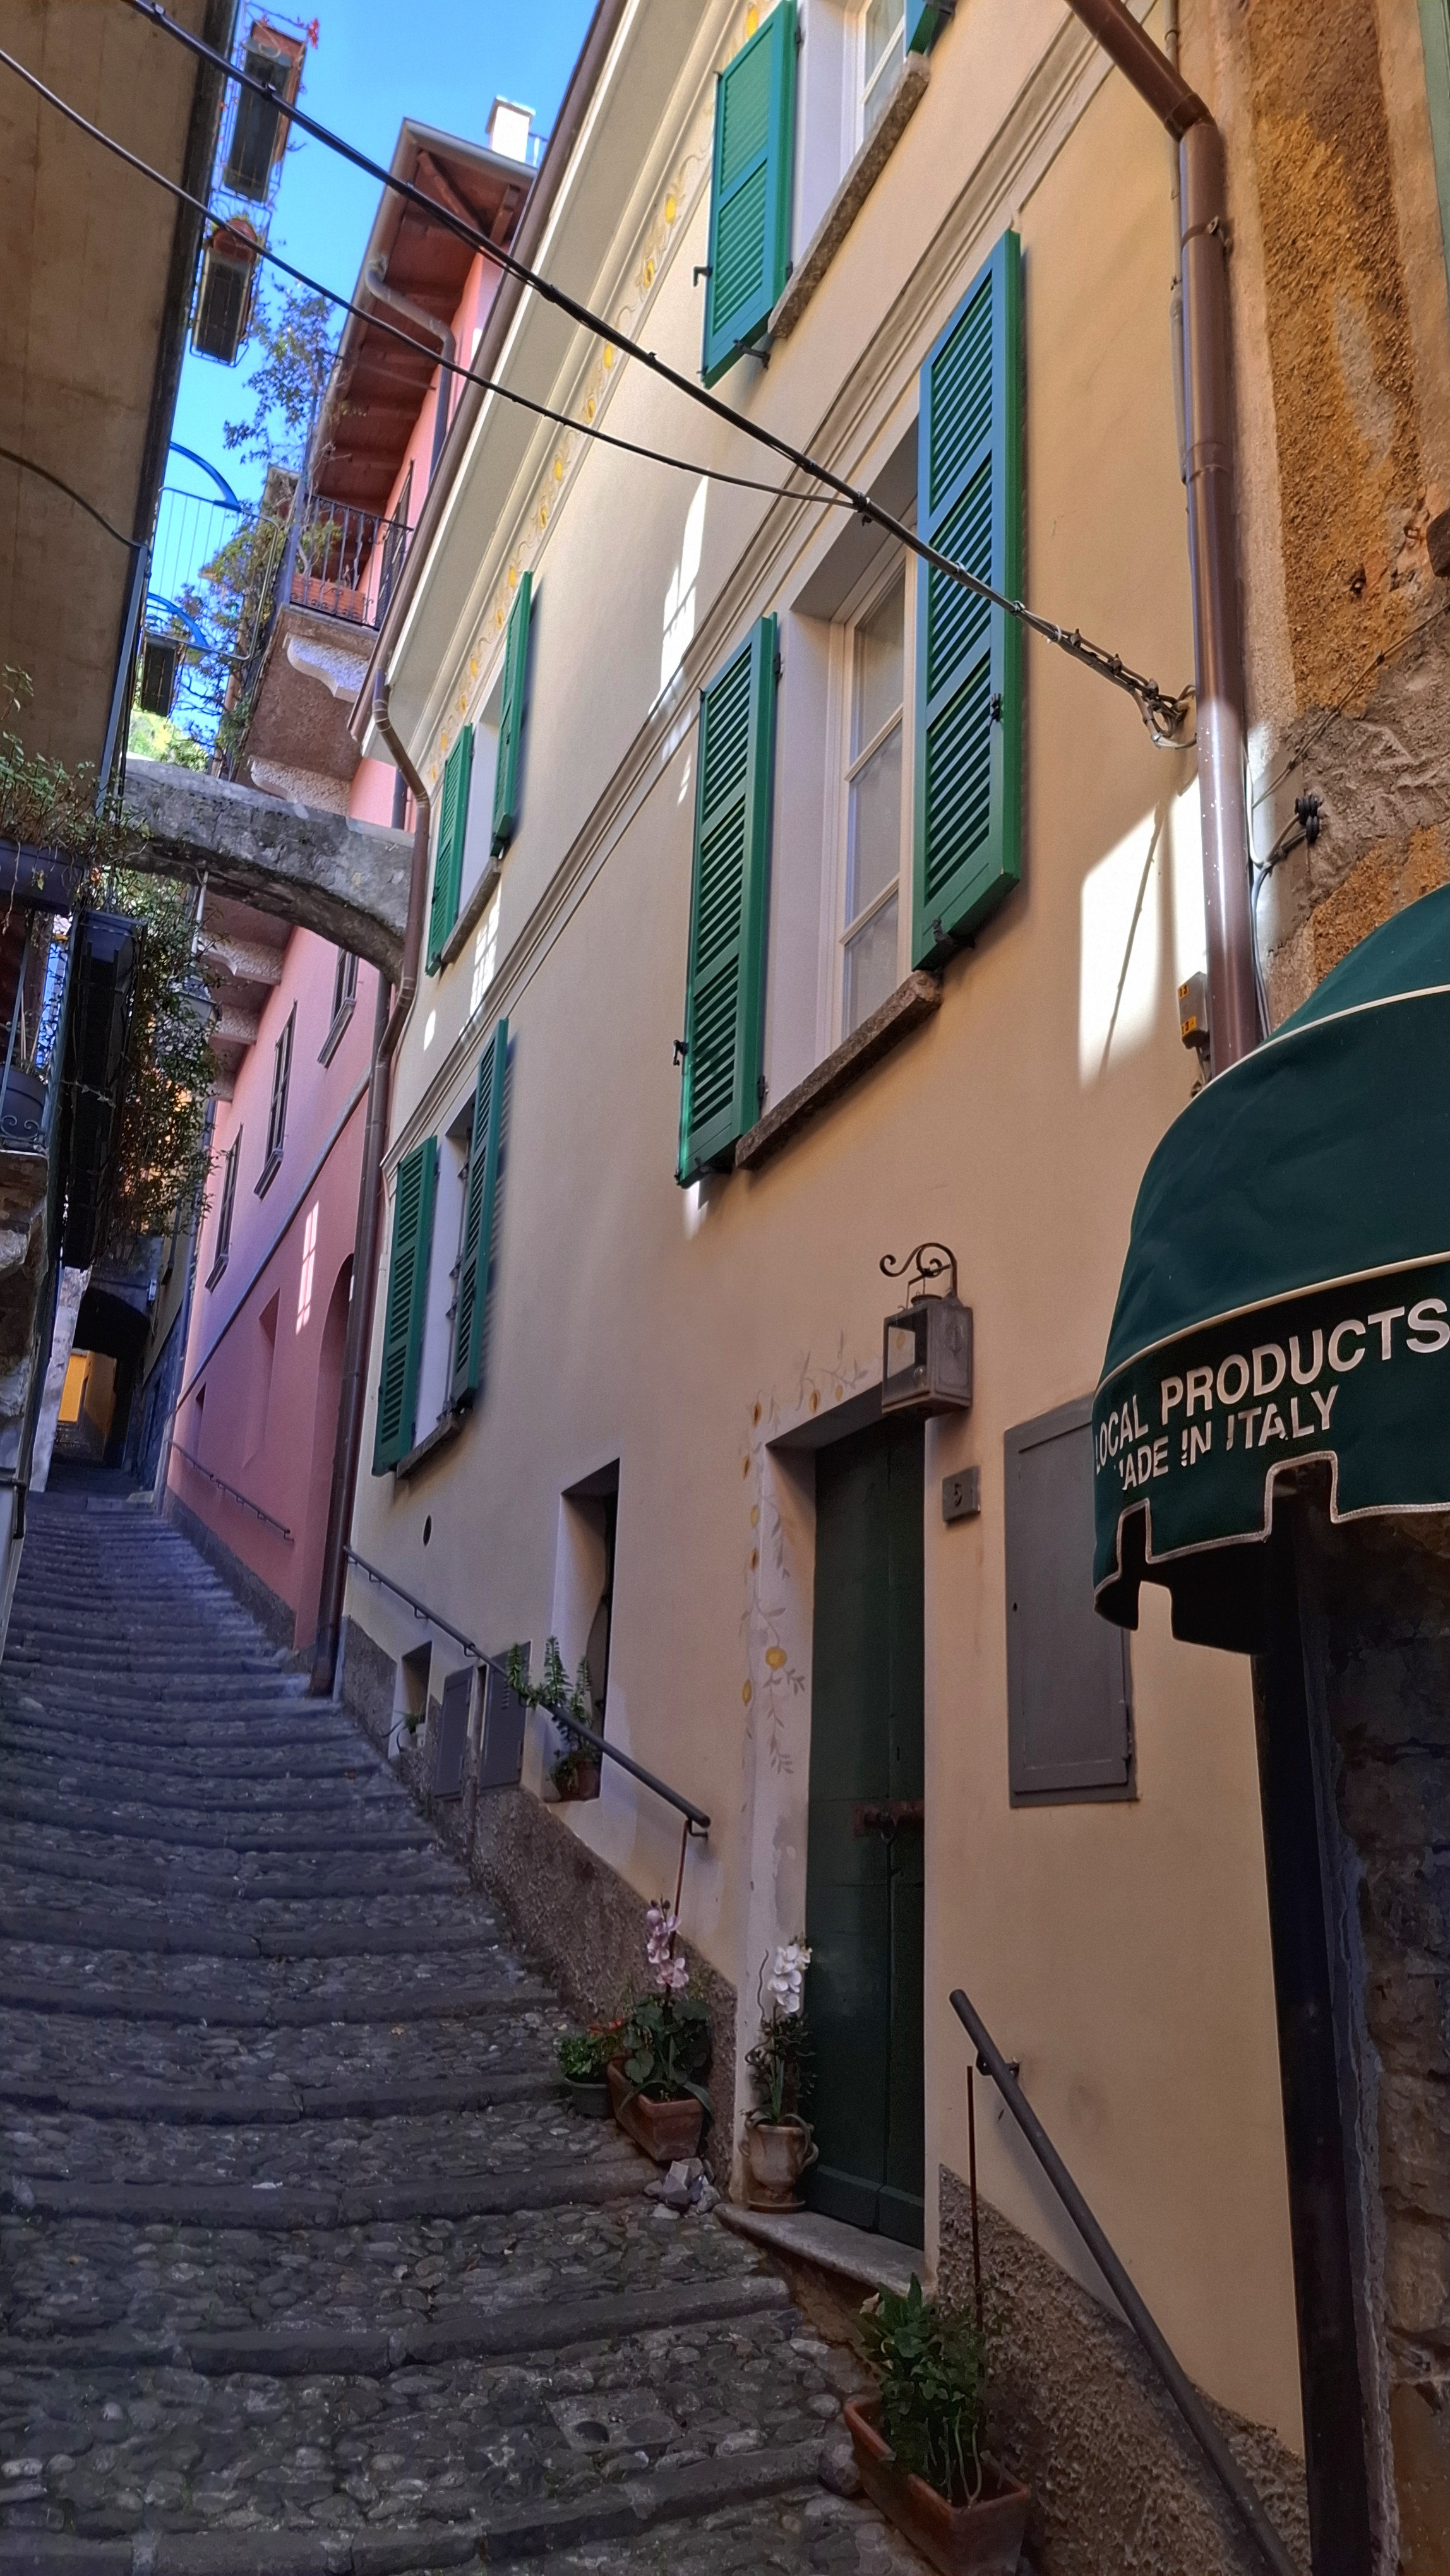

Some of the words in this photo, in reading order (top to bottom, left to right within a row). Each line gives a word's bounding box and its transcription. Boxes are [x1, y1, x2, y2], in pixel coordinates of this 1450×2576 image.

[1161, 1298, 1450, 1425] PRODUCTS
[1181, 1421, 1211, 1467] IN
[1226, 1385, 1339, 1451] ITALY
[954, 1482, 962, 1507] 5
